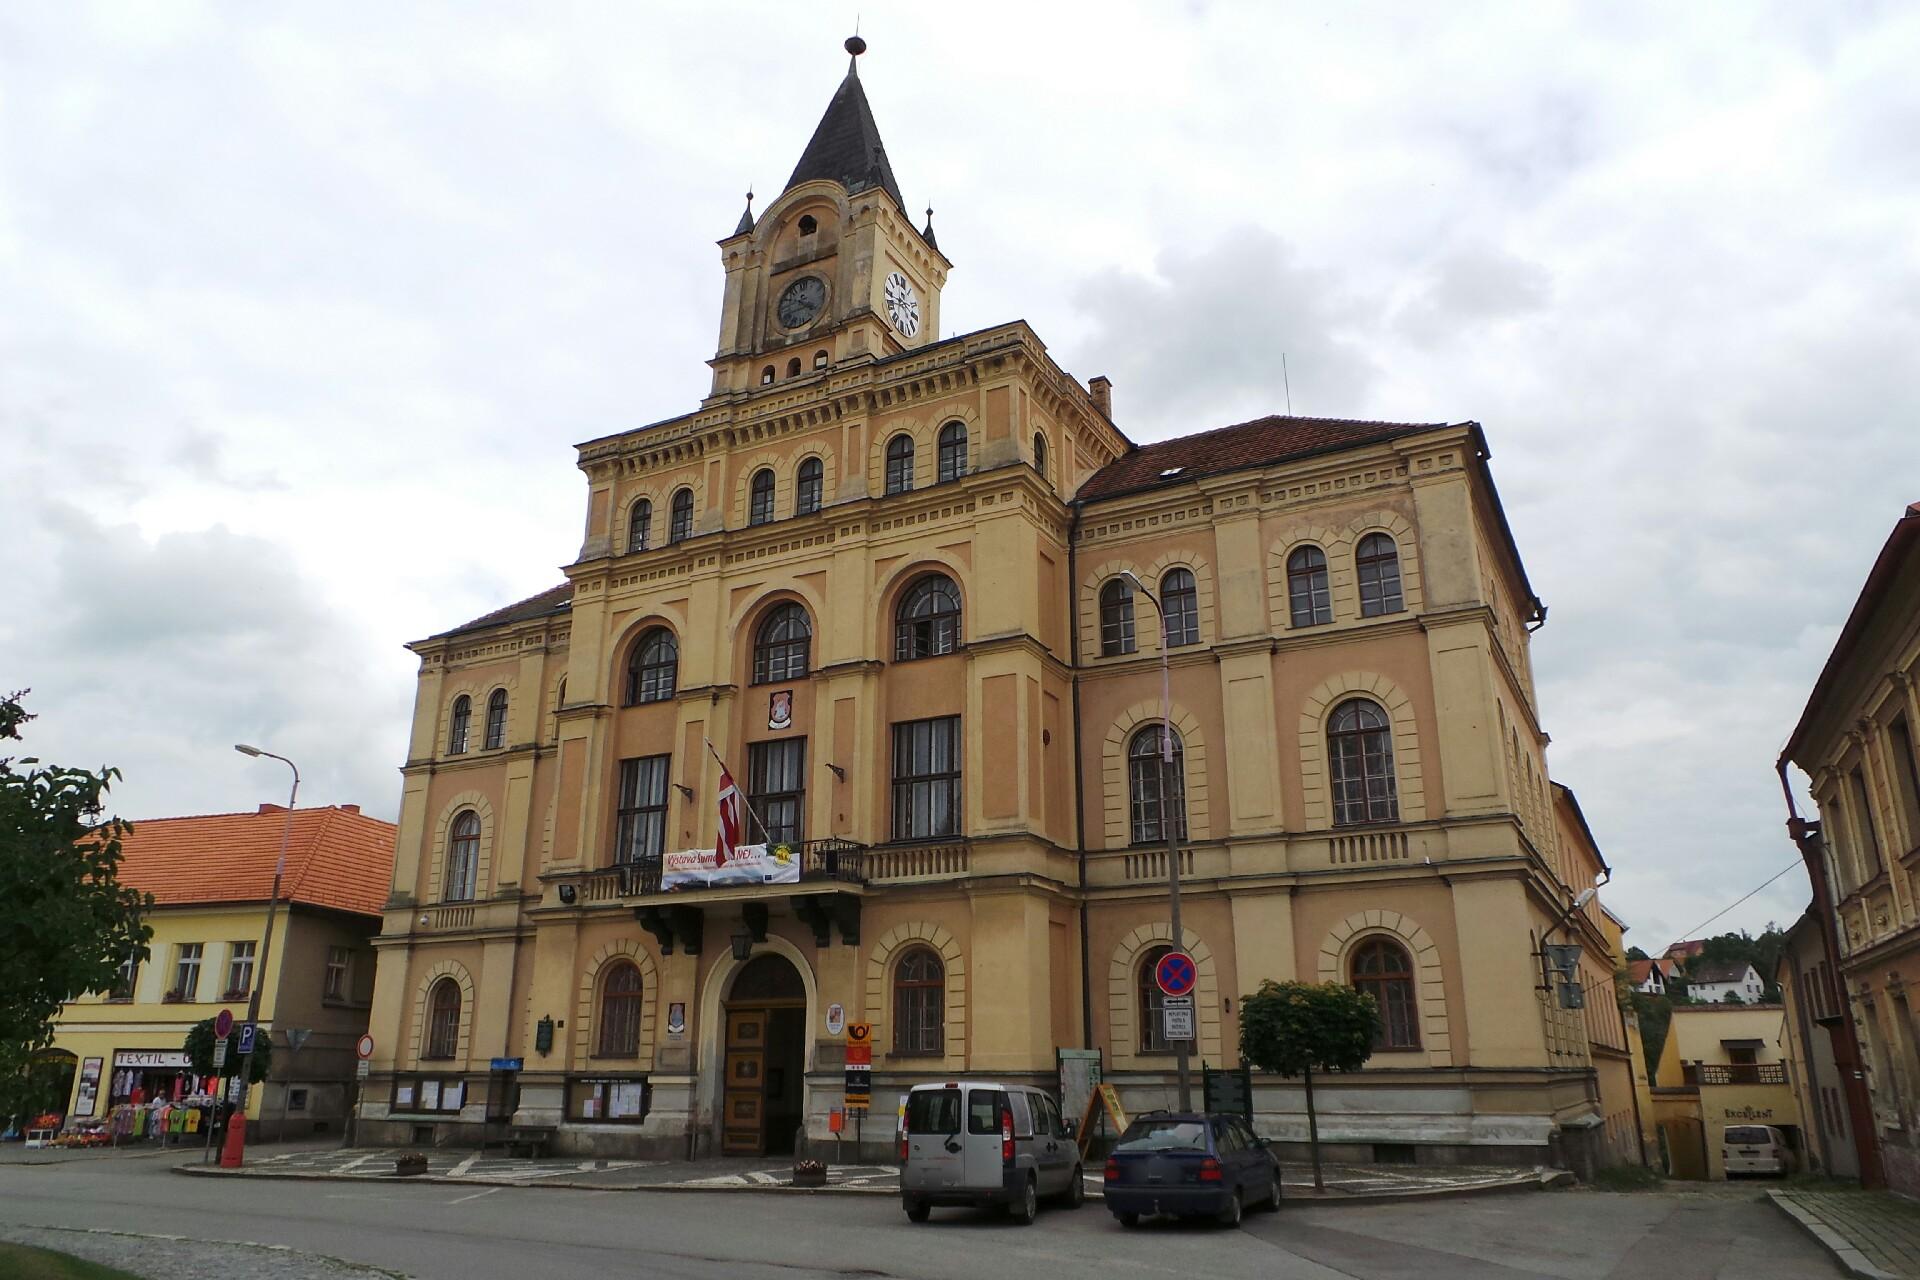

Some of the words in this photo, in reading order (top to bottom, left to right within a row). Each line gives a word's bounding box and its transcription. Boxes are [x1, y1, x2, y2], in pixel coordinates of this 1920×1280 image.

[667, 854, 696, 867] Výstava
[242, 1026, 252, 1044] P
[119, 1053, 165, 1065] TEXTIL
[1724, 1108, 1773, 1120] EXCELLENT
